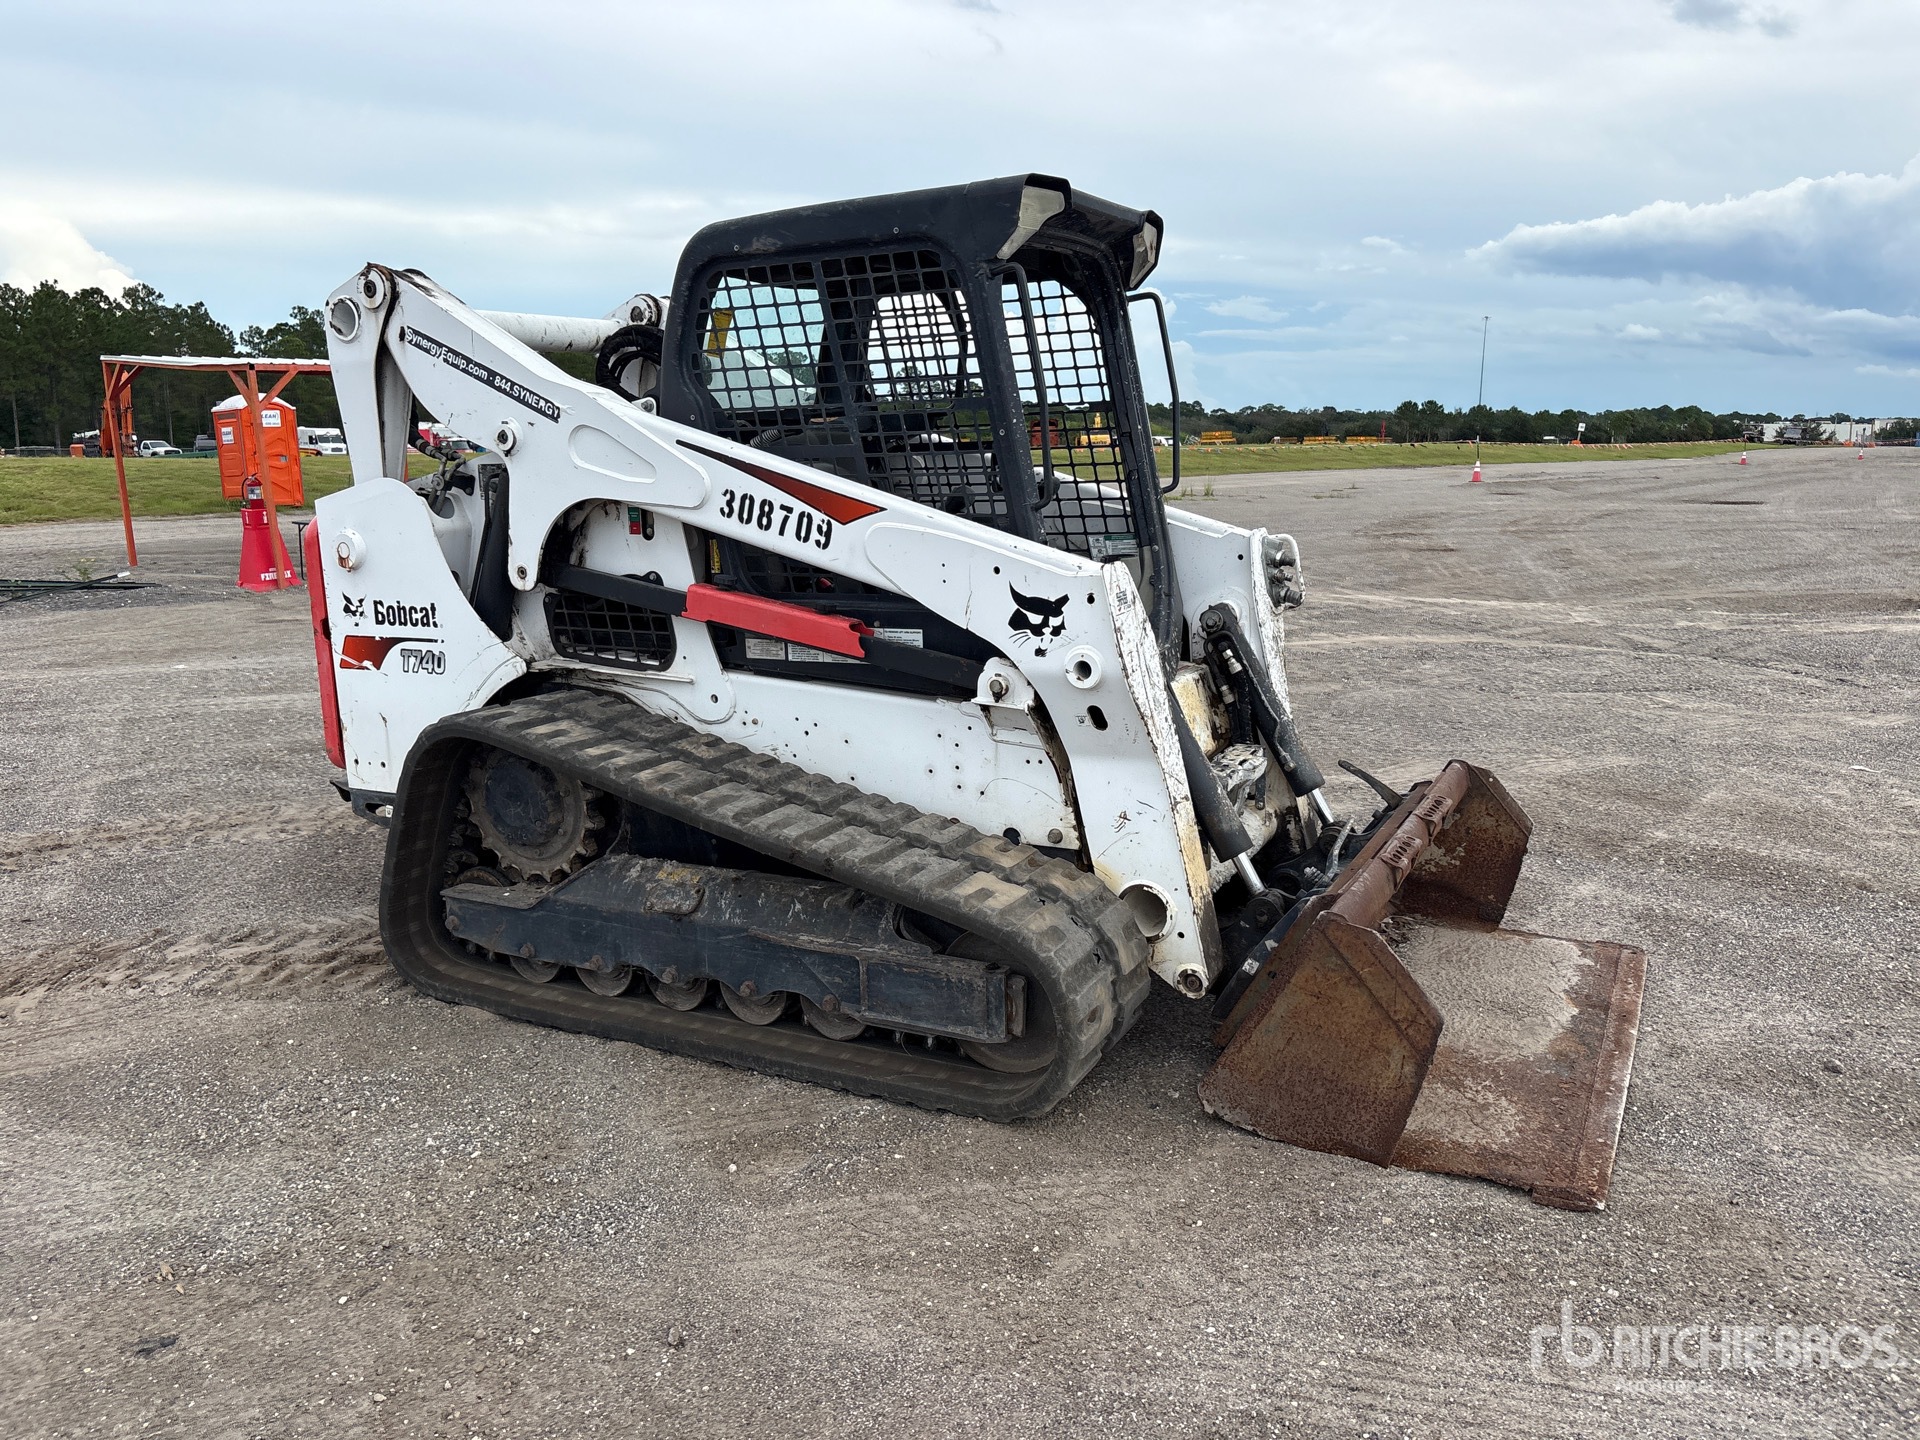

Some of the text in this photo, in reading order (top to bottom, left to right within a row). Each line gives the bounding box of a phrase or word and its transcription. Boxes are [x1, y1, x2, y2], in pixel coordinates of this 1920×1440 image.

[406, 328, 487, 380] SynergyEquip.com
[720, 488, 833, 550] 308709
[373, 600, 438, 628] Bobcat
[400, 648, 446, 675] T740
